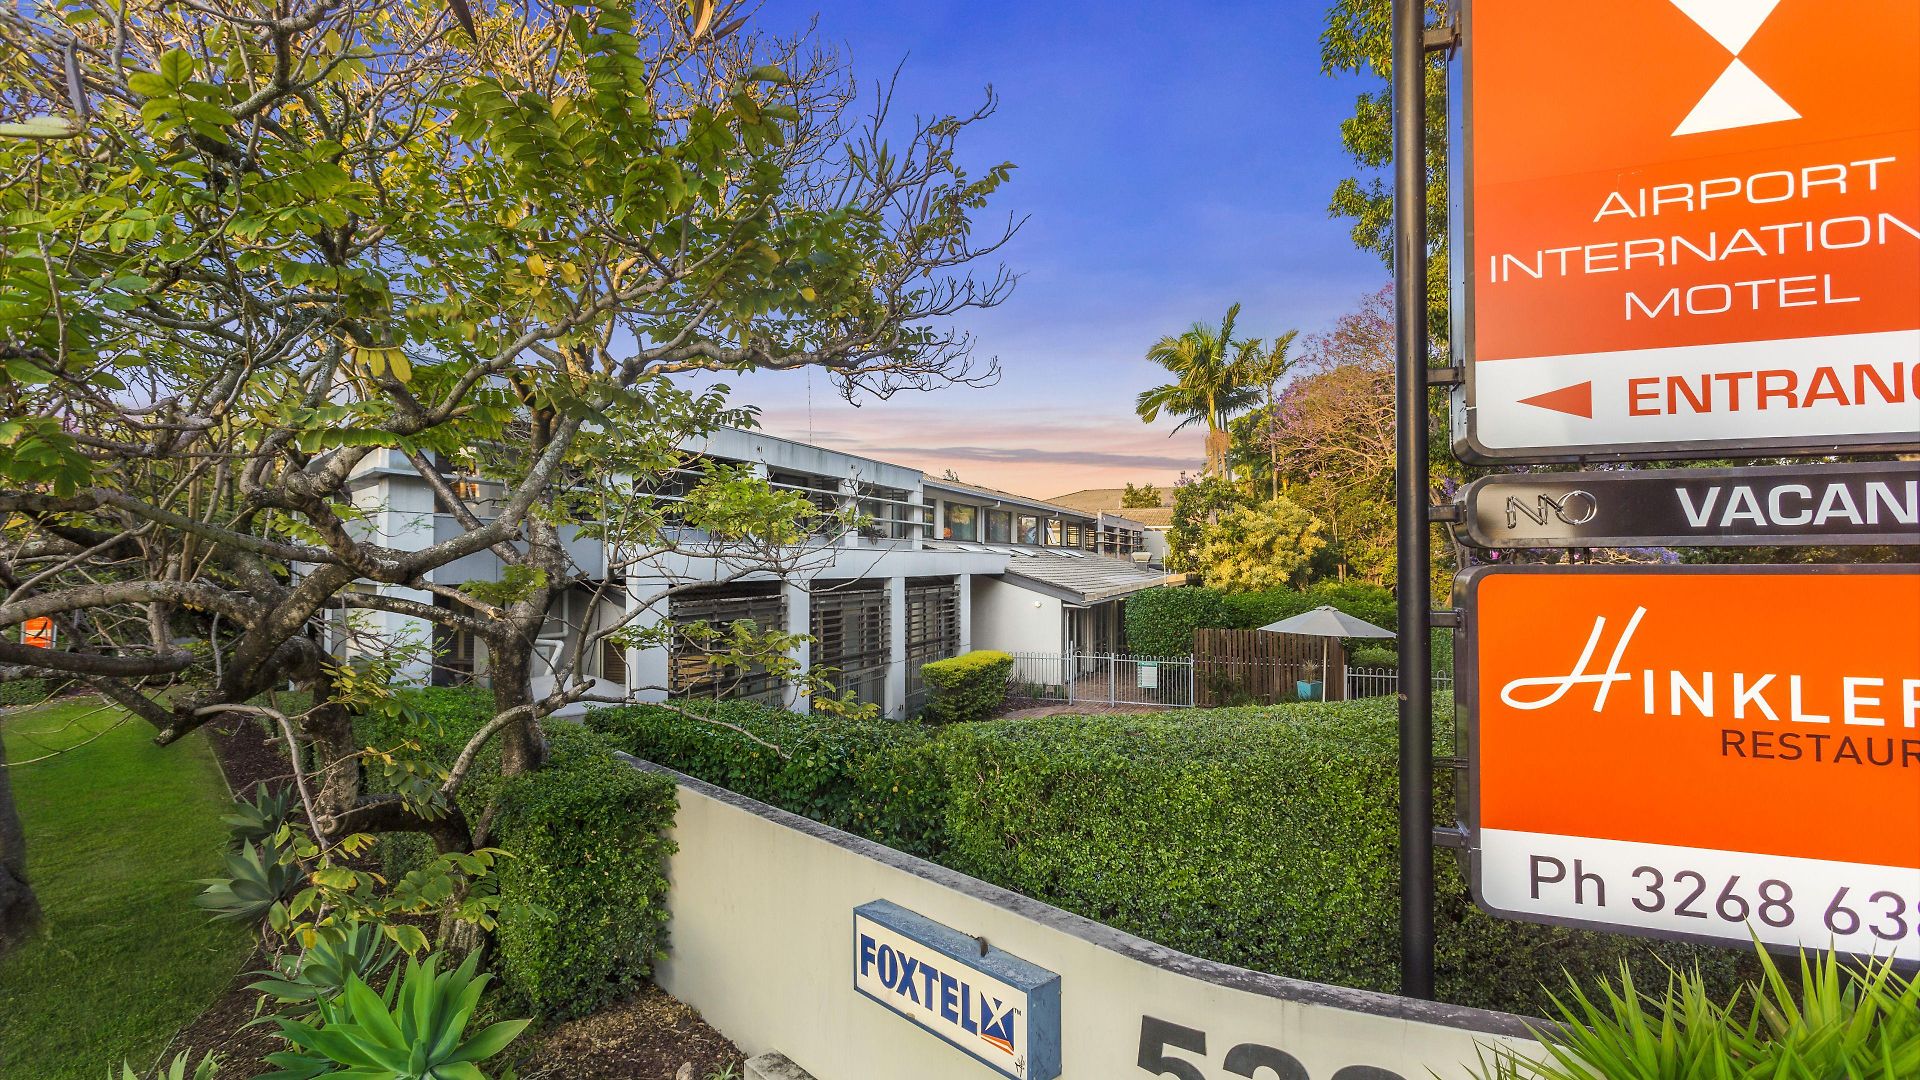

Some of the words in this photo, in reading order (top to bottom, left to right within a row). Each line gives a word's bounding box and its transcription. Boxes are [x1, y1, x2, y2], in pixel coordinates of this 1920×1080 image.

[1593, 156, 1896, 223] AIRPORT
[1625, 273, 1861, 321] MOTEL
[1628, 361, 1920, 417] ENTRAN
[1675, 480, 1919, 528] VACAN
[1528, 854, 1606, 907] Ph
[1631, 865, 1795, 928] 3268
[1823, 886, 1920, 941] 63
[860, 932, 978, 1037] FOXTEL
